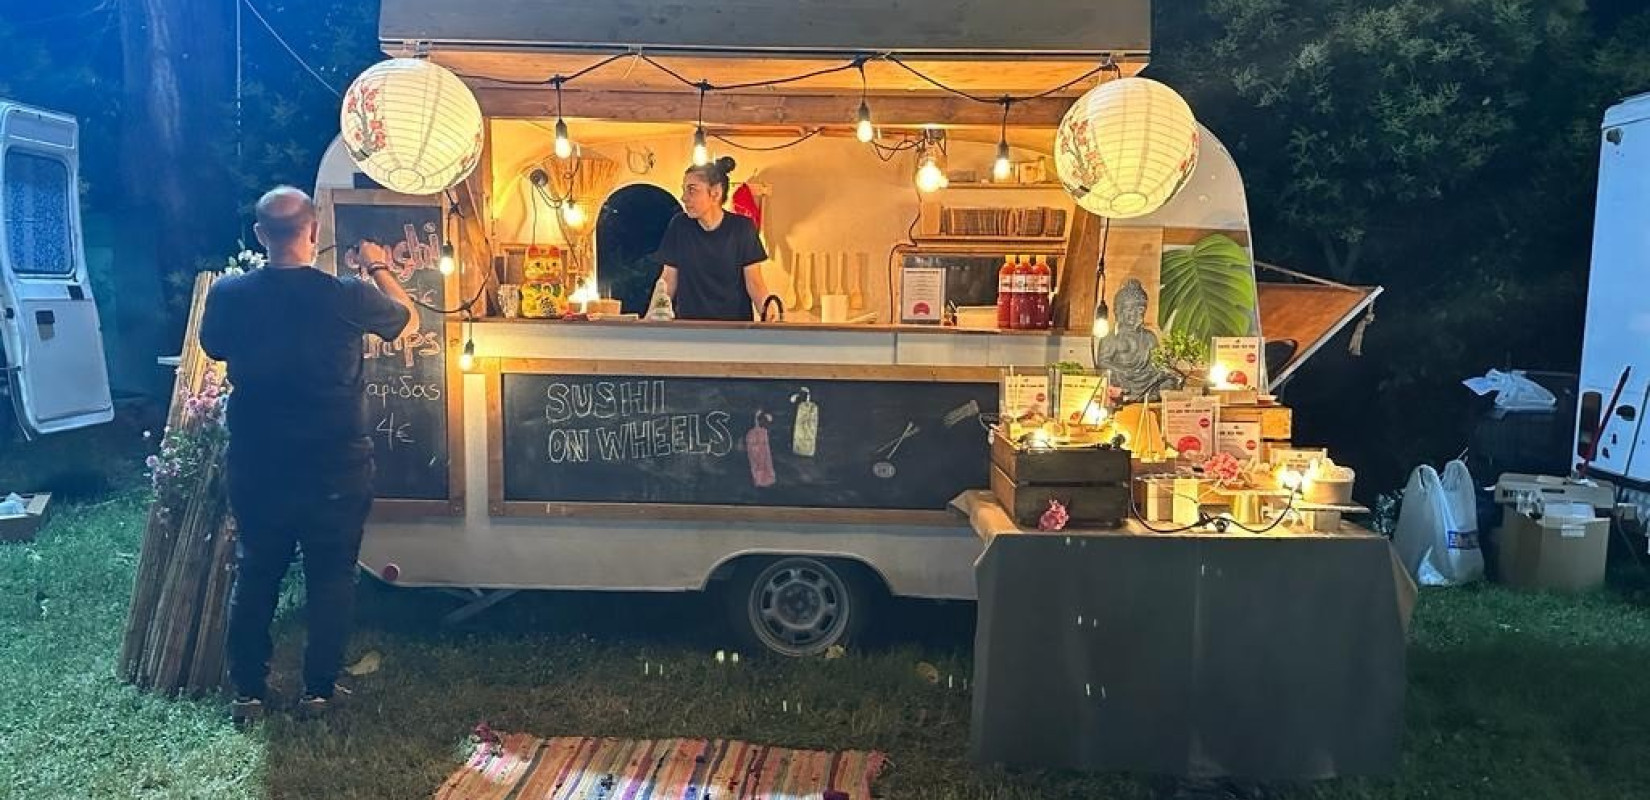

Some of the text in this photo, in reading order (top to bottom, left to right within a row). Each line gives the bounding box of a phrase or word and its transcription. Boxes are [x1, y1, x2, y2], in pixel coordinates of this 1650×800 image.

[545, 380, 666, 423] SUSHI
[376, 412, 416, 451] 4€
[549, 410, 733, 463] ON WHEELS
